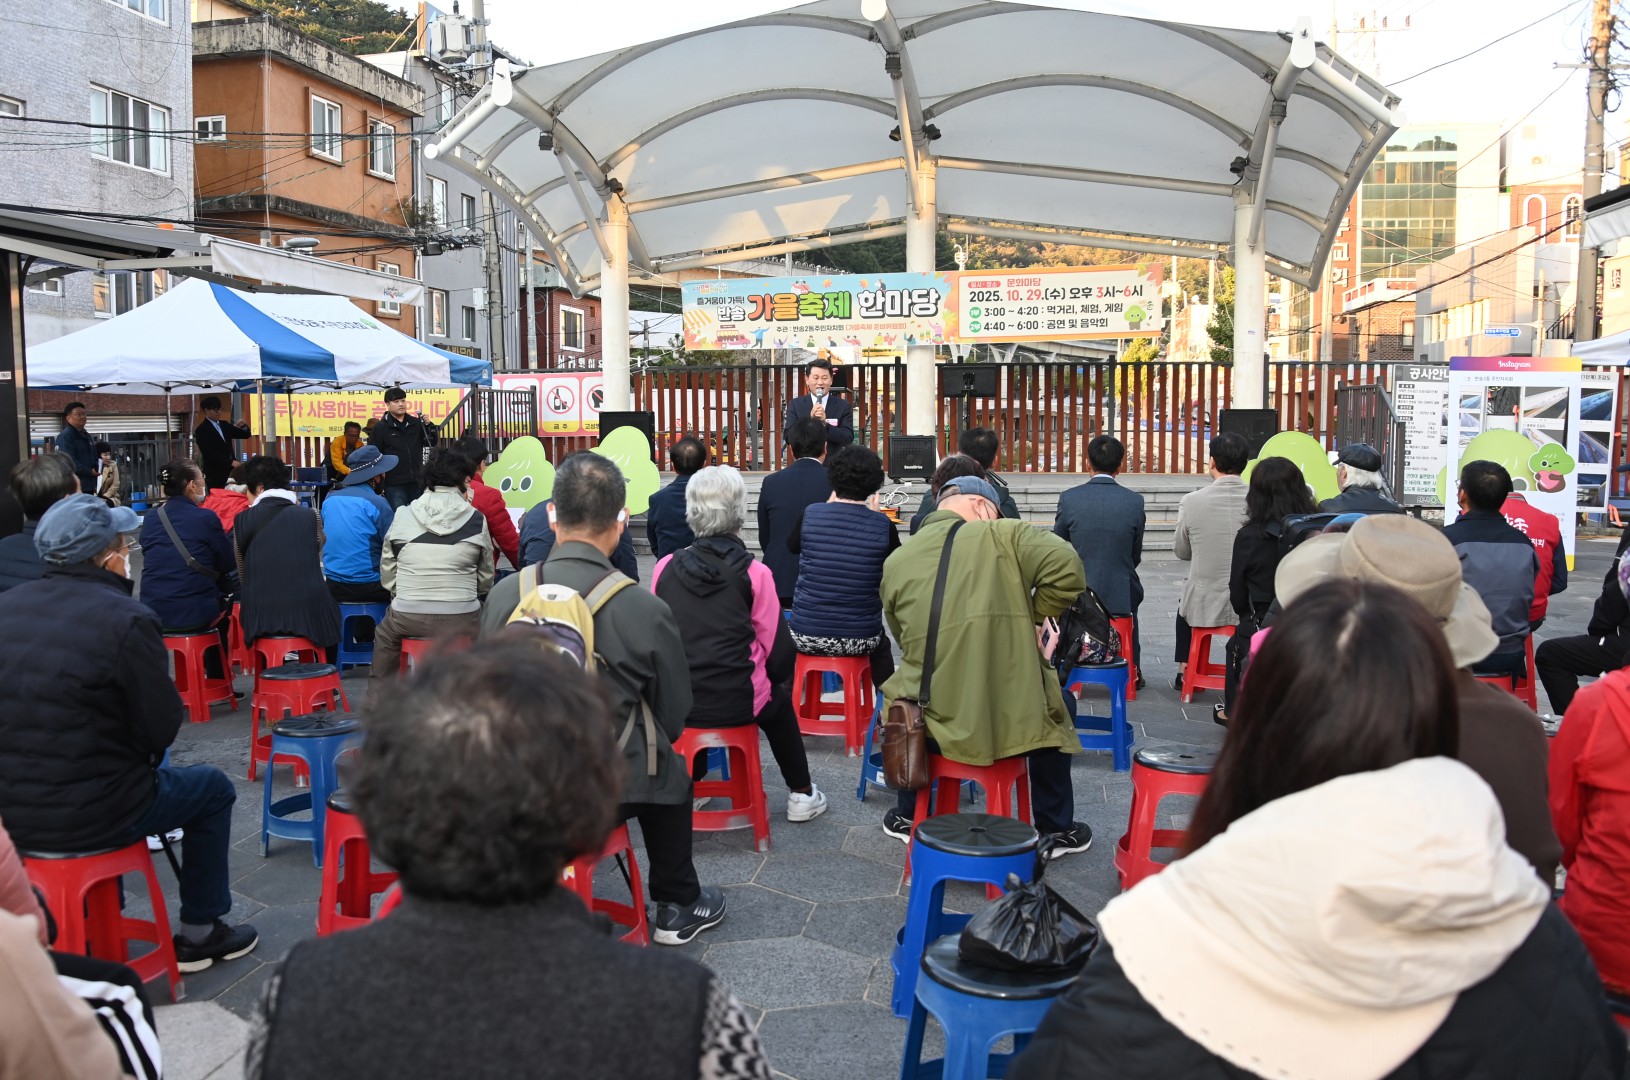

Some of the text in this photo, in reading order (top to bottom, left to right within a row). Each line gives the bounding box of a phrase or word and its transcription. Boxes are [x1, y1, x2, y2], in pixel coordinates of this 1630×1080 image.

[1007, 277, 1041, 288] 문화마당
[697, 296, 745, 305] 즐거움이 가득!
[969, 290, 1003, 303] 2025.
[1007, 289, 1023, 302] 10.
[1069, 286, 1093, 299] 오후
[1096, 284, 1143, 298] 3시~6시
[717, 286, 941, 322] 반송 가을축제 한마당
[984, 307, 1006, 317] 3:00
[1017, 306, 1039, 316] 4:20
[1047, 304, 1078, 315] 먹거리,
[1080, 303, 1102, 314] 체험,
[1104, 302, 1124, 313] 게임
[776, 325, 789, 333] 주관
[984, 321, 1006, 331] 4:40
[1017, 320, 1039, 331] 6:00
[1047, 319, 1066, 330] 공연
[1068, 318, 1078, 329] 및
[1080, 317, 1109, 328] 음악회
[1498, 360, 1532, 370] Instagram
[261, 399, 451, 419] 두가 사용하는 공입니다
